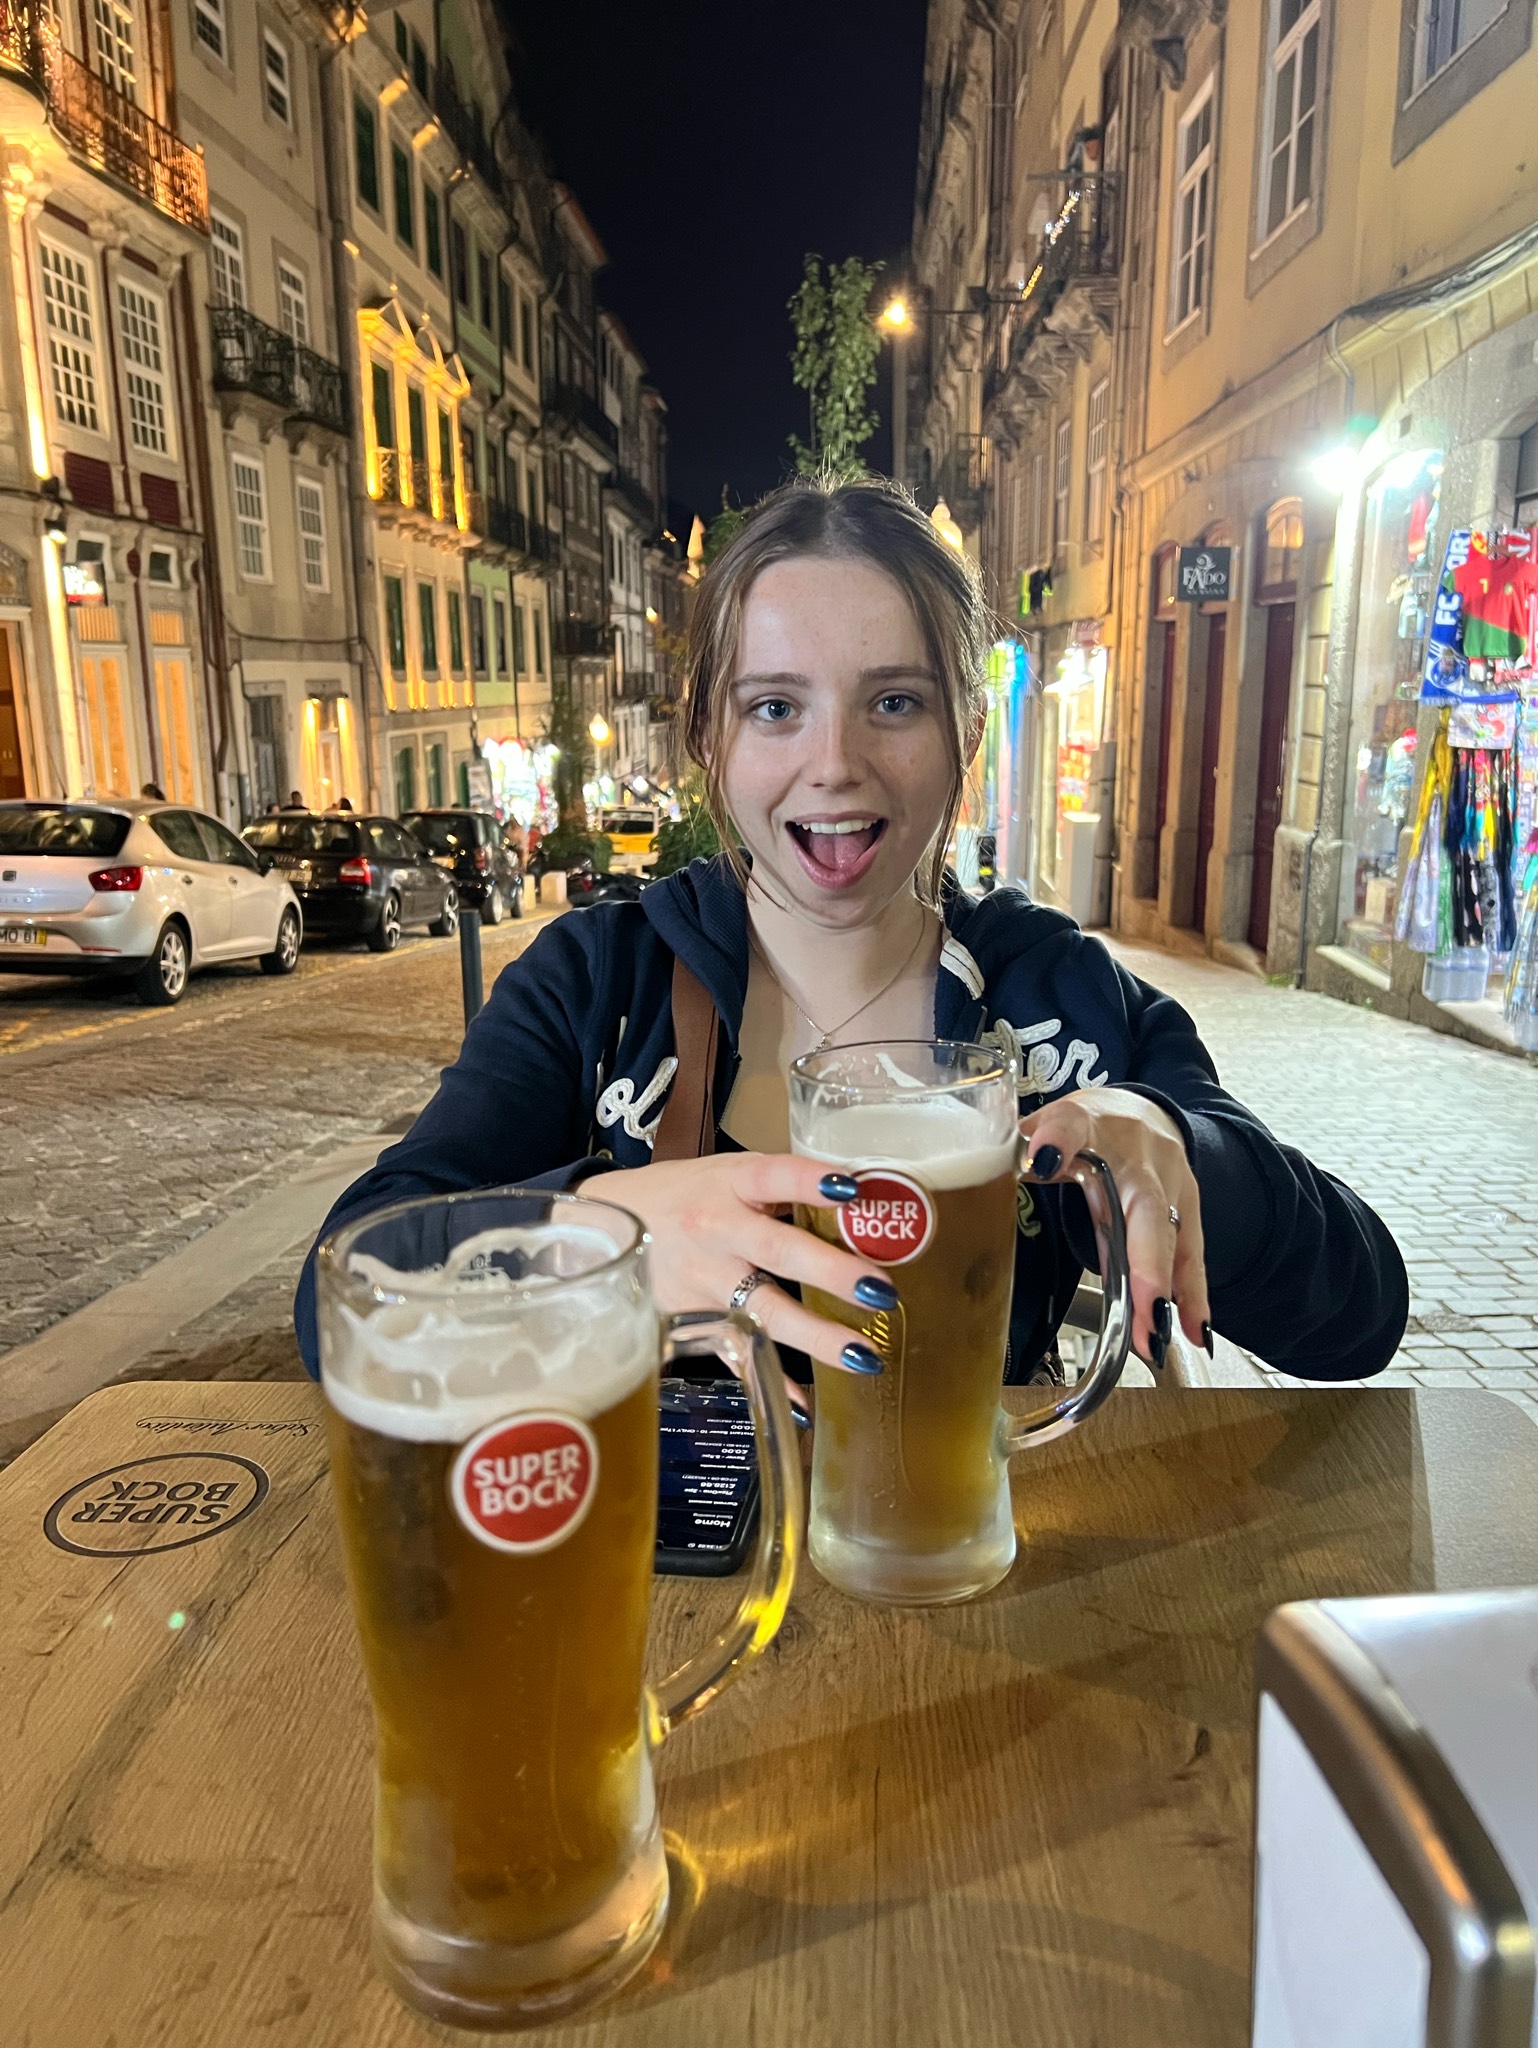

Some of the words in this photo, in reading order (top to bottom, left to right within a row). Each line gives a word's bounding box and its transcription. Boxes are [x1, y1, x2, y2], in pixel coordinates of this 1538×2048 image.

[1183, 566, 1227, 590] FADO
[1435, 592, 1460, 625] FC
[848, 1198, 919, 1220] SUPER
[852, 1217, 917, 1240] BOCK
[246, 1421, 320, 1437] Sabor
[472, 1443, 582, 1489] SUPER
[100, 1479, 241, 1503] BOCK
[479, 1472, 577, 1517] BOCK
[71, 1501, 231, 1526] SUPER
[694, 1518, 731, 1528] Home
